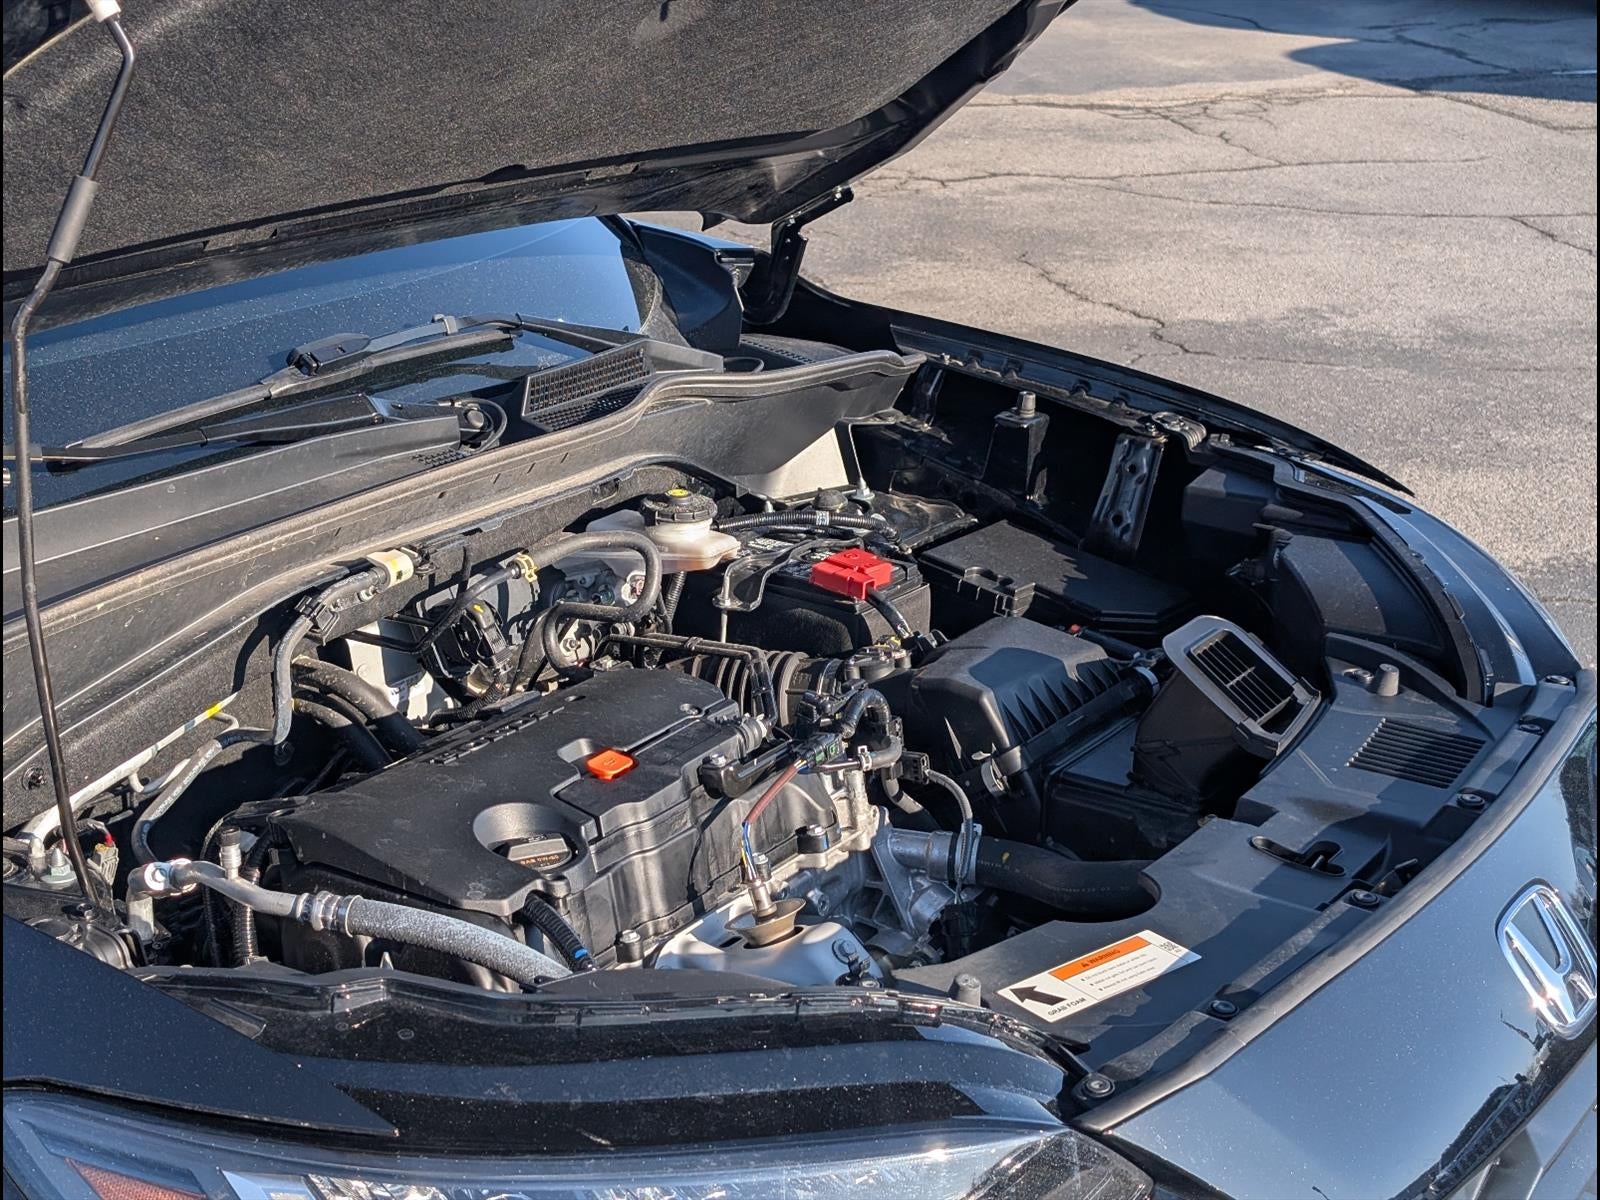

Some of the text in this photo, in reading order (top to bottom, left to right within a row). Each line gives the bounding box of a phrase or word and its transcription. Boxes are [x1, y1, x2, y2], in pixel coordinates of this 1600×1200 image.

[1088, 949, 1121, 964] WARNING
[1047, 997, 1086, 1016] GRAB FOAM
